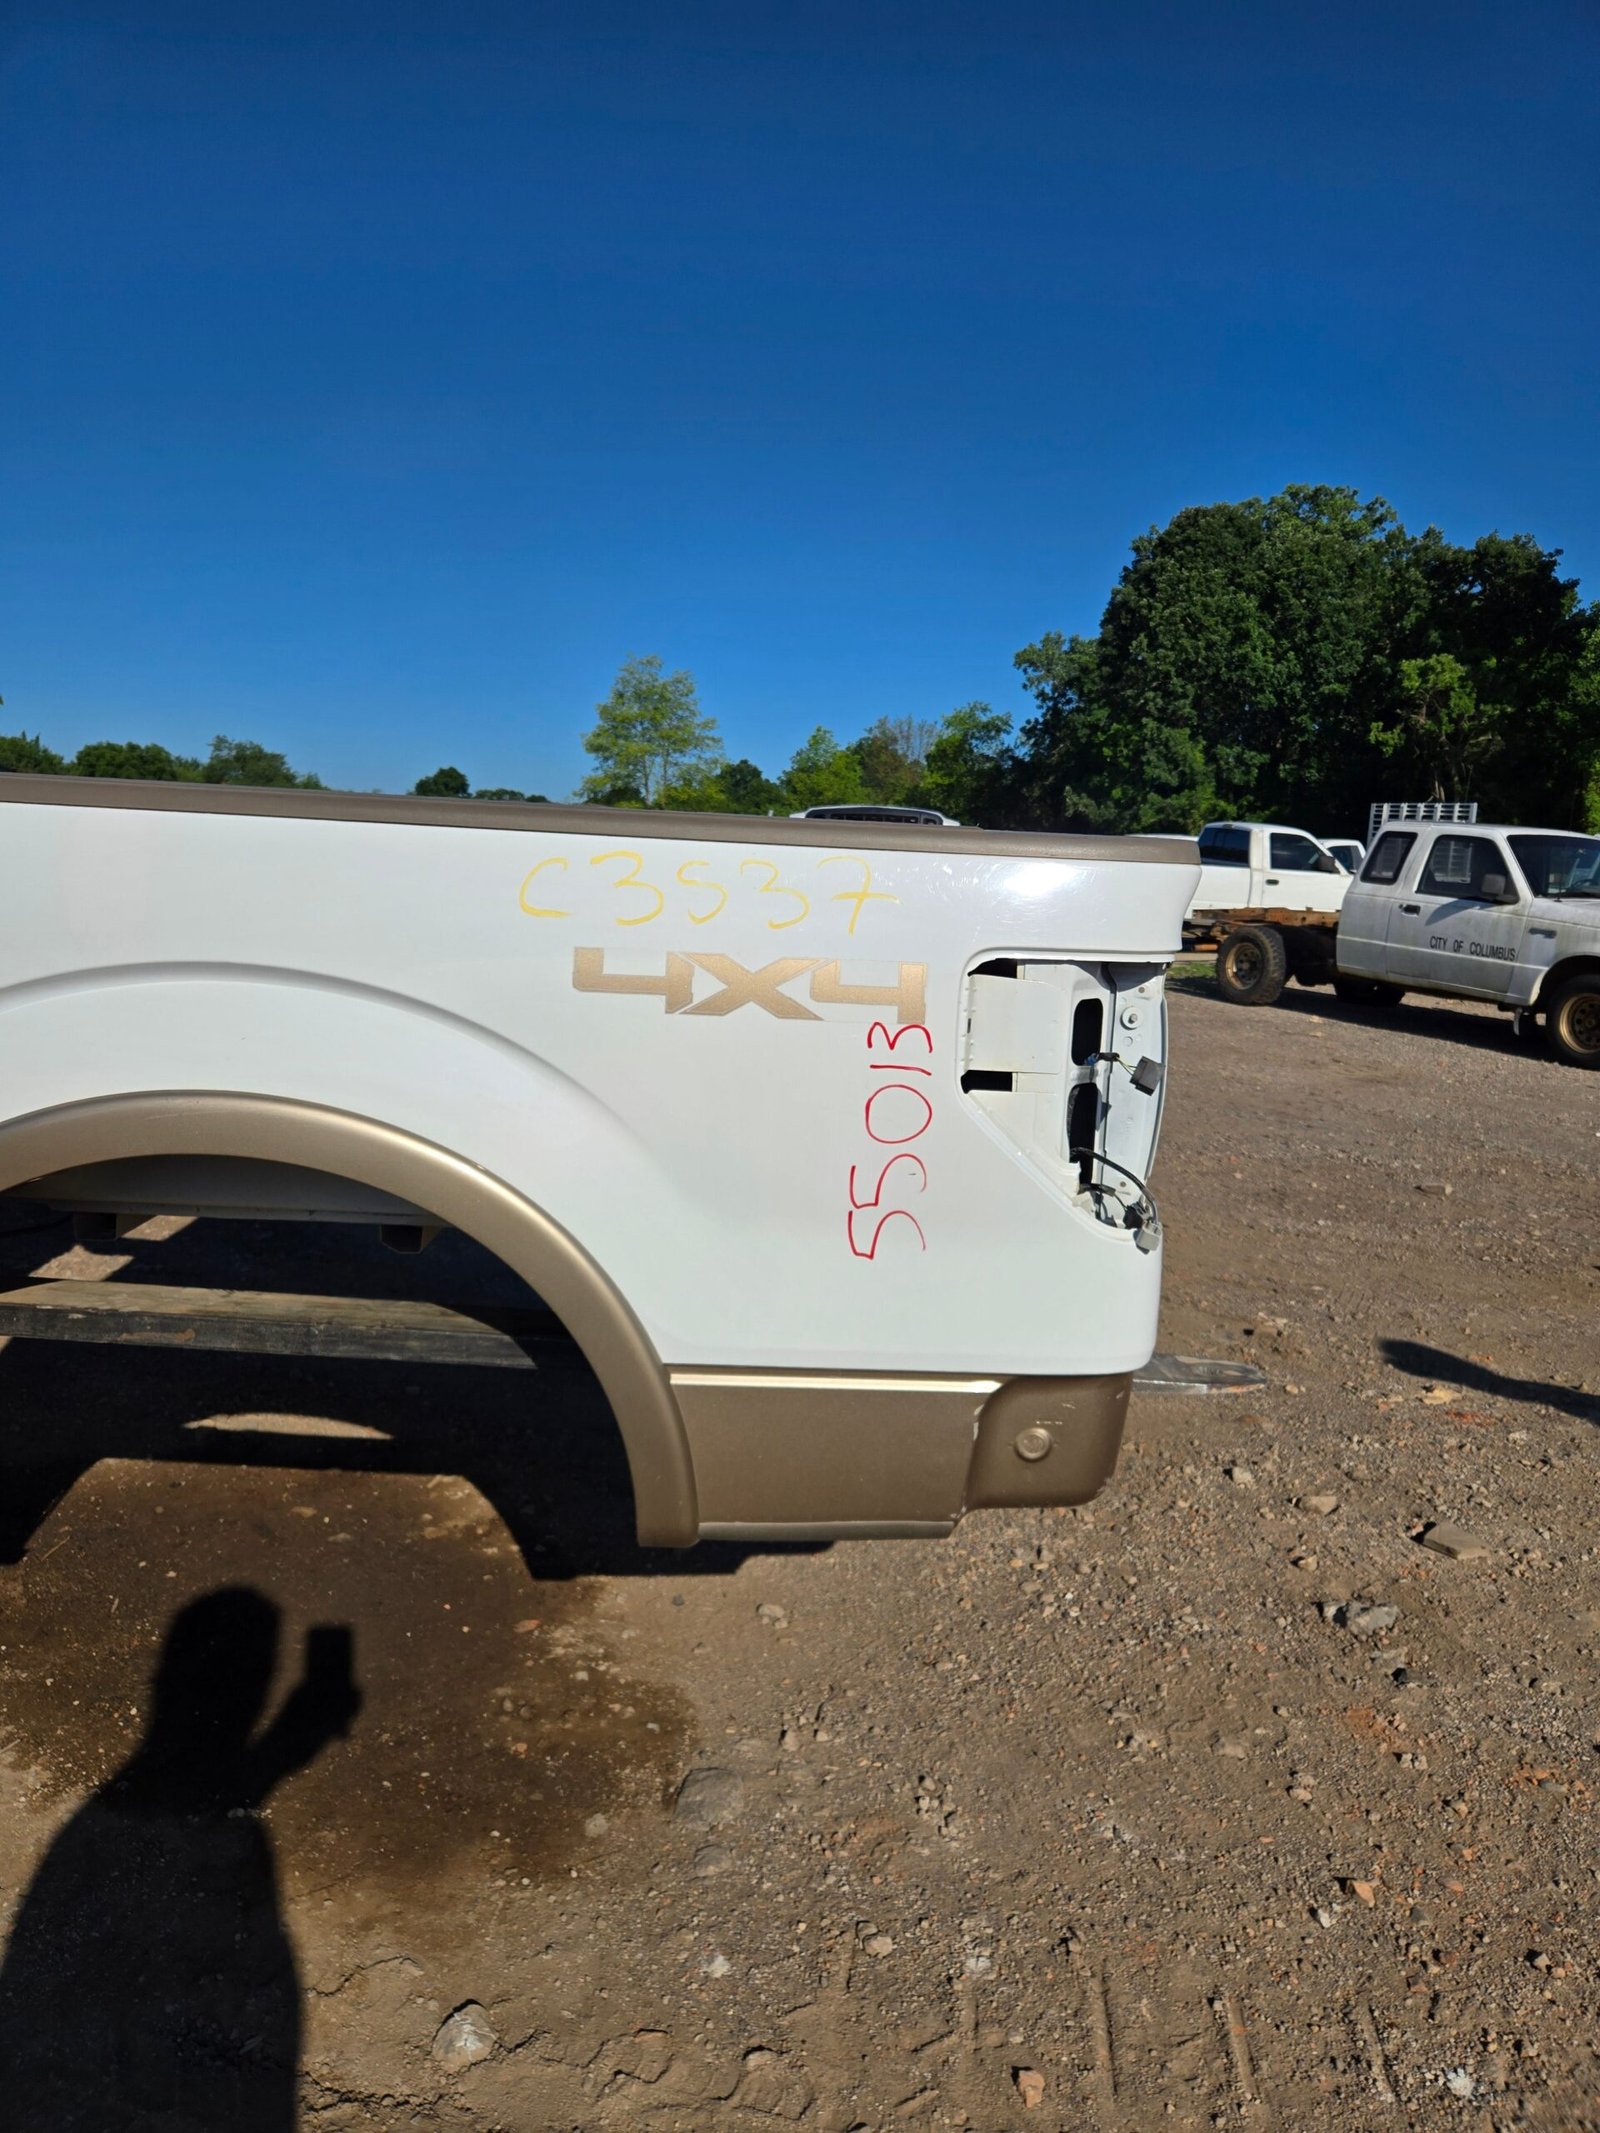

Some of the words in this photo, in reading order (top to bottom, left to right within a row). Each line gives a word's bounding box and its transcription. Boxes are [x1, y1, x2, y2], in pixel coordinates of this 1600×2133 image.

[1429, 935, 1448, 951] CITY
[1453, 939, 1464, 953] OF
[1469, 941, 1517, 961] COLUMBUS
[848, 1021, 933, 1260] 55013
